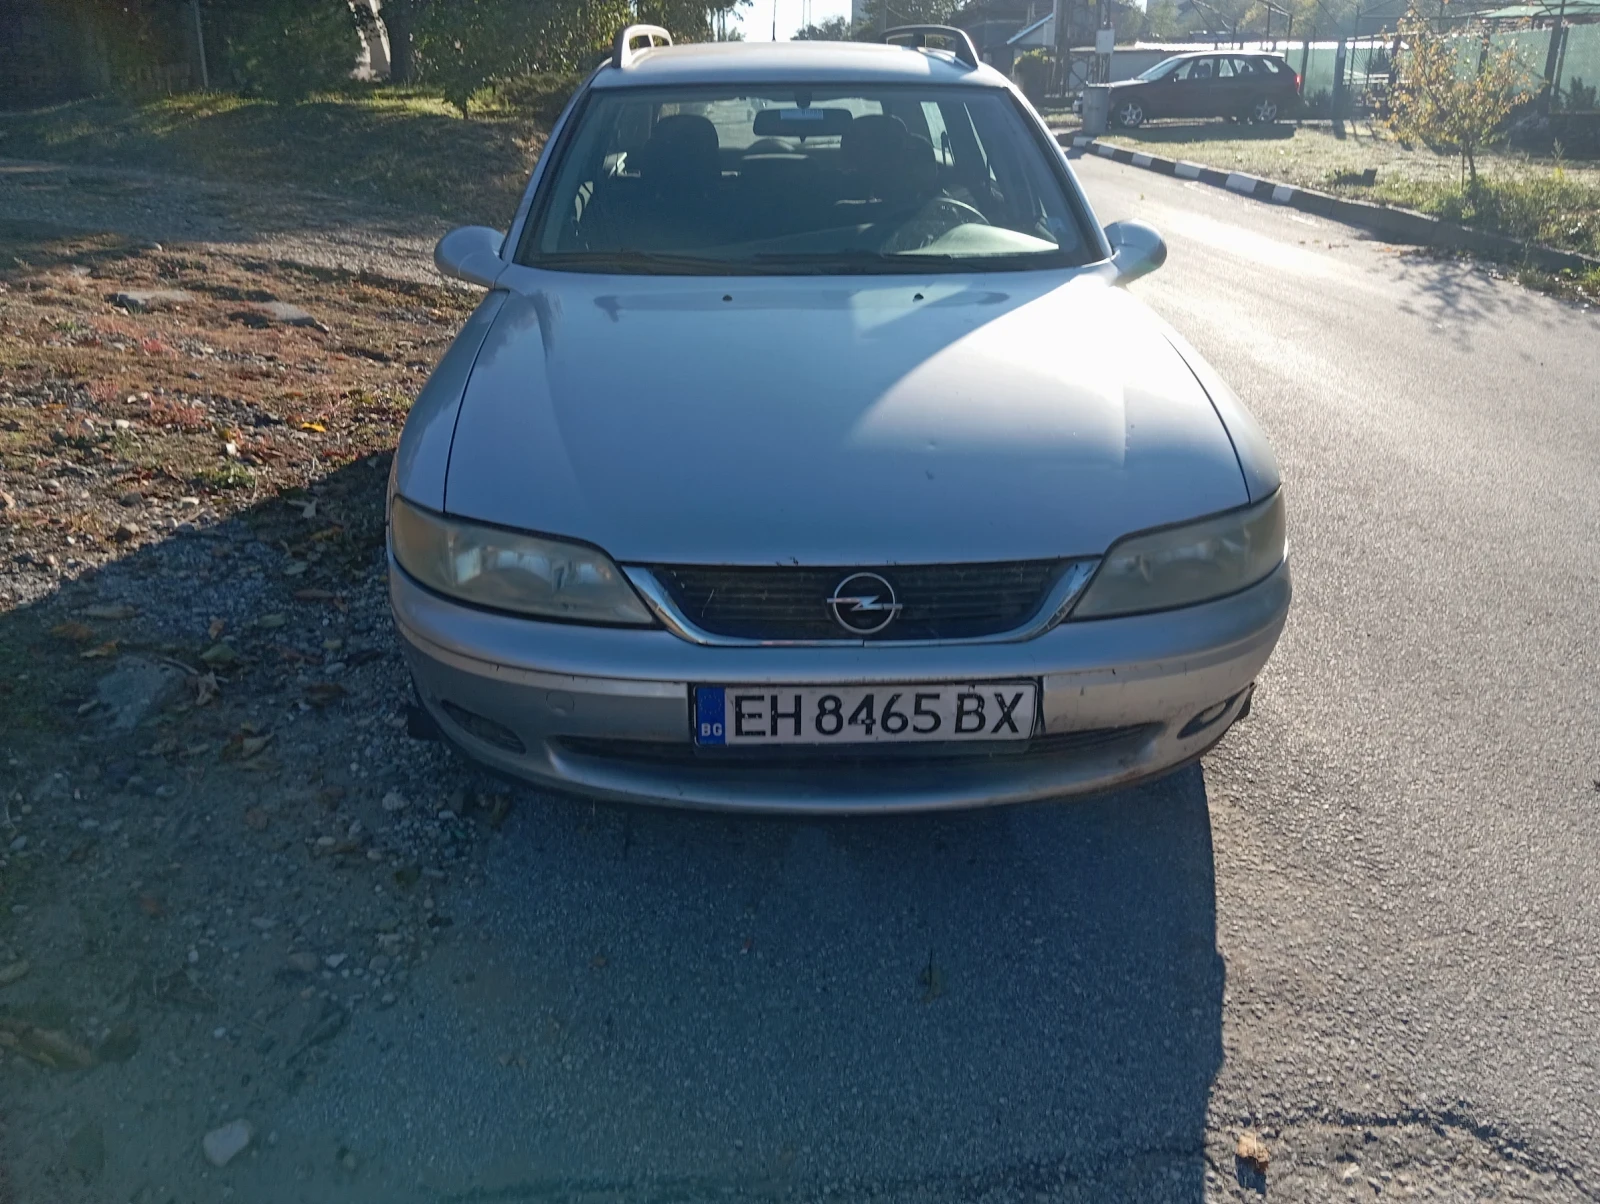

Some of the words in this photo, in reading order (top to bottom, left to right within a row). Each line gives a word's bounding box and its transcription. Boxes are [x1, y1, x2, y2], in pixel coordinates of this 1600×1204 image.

[734, 694, 802, 736] EH
[815, 692, 941, 735] 8465
[954, 692, 1024, 734] BX
[701, 723, 722, 737] BG
